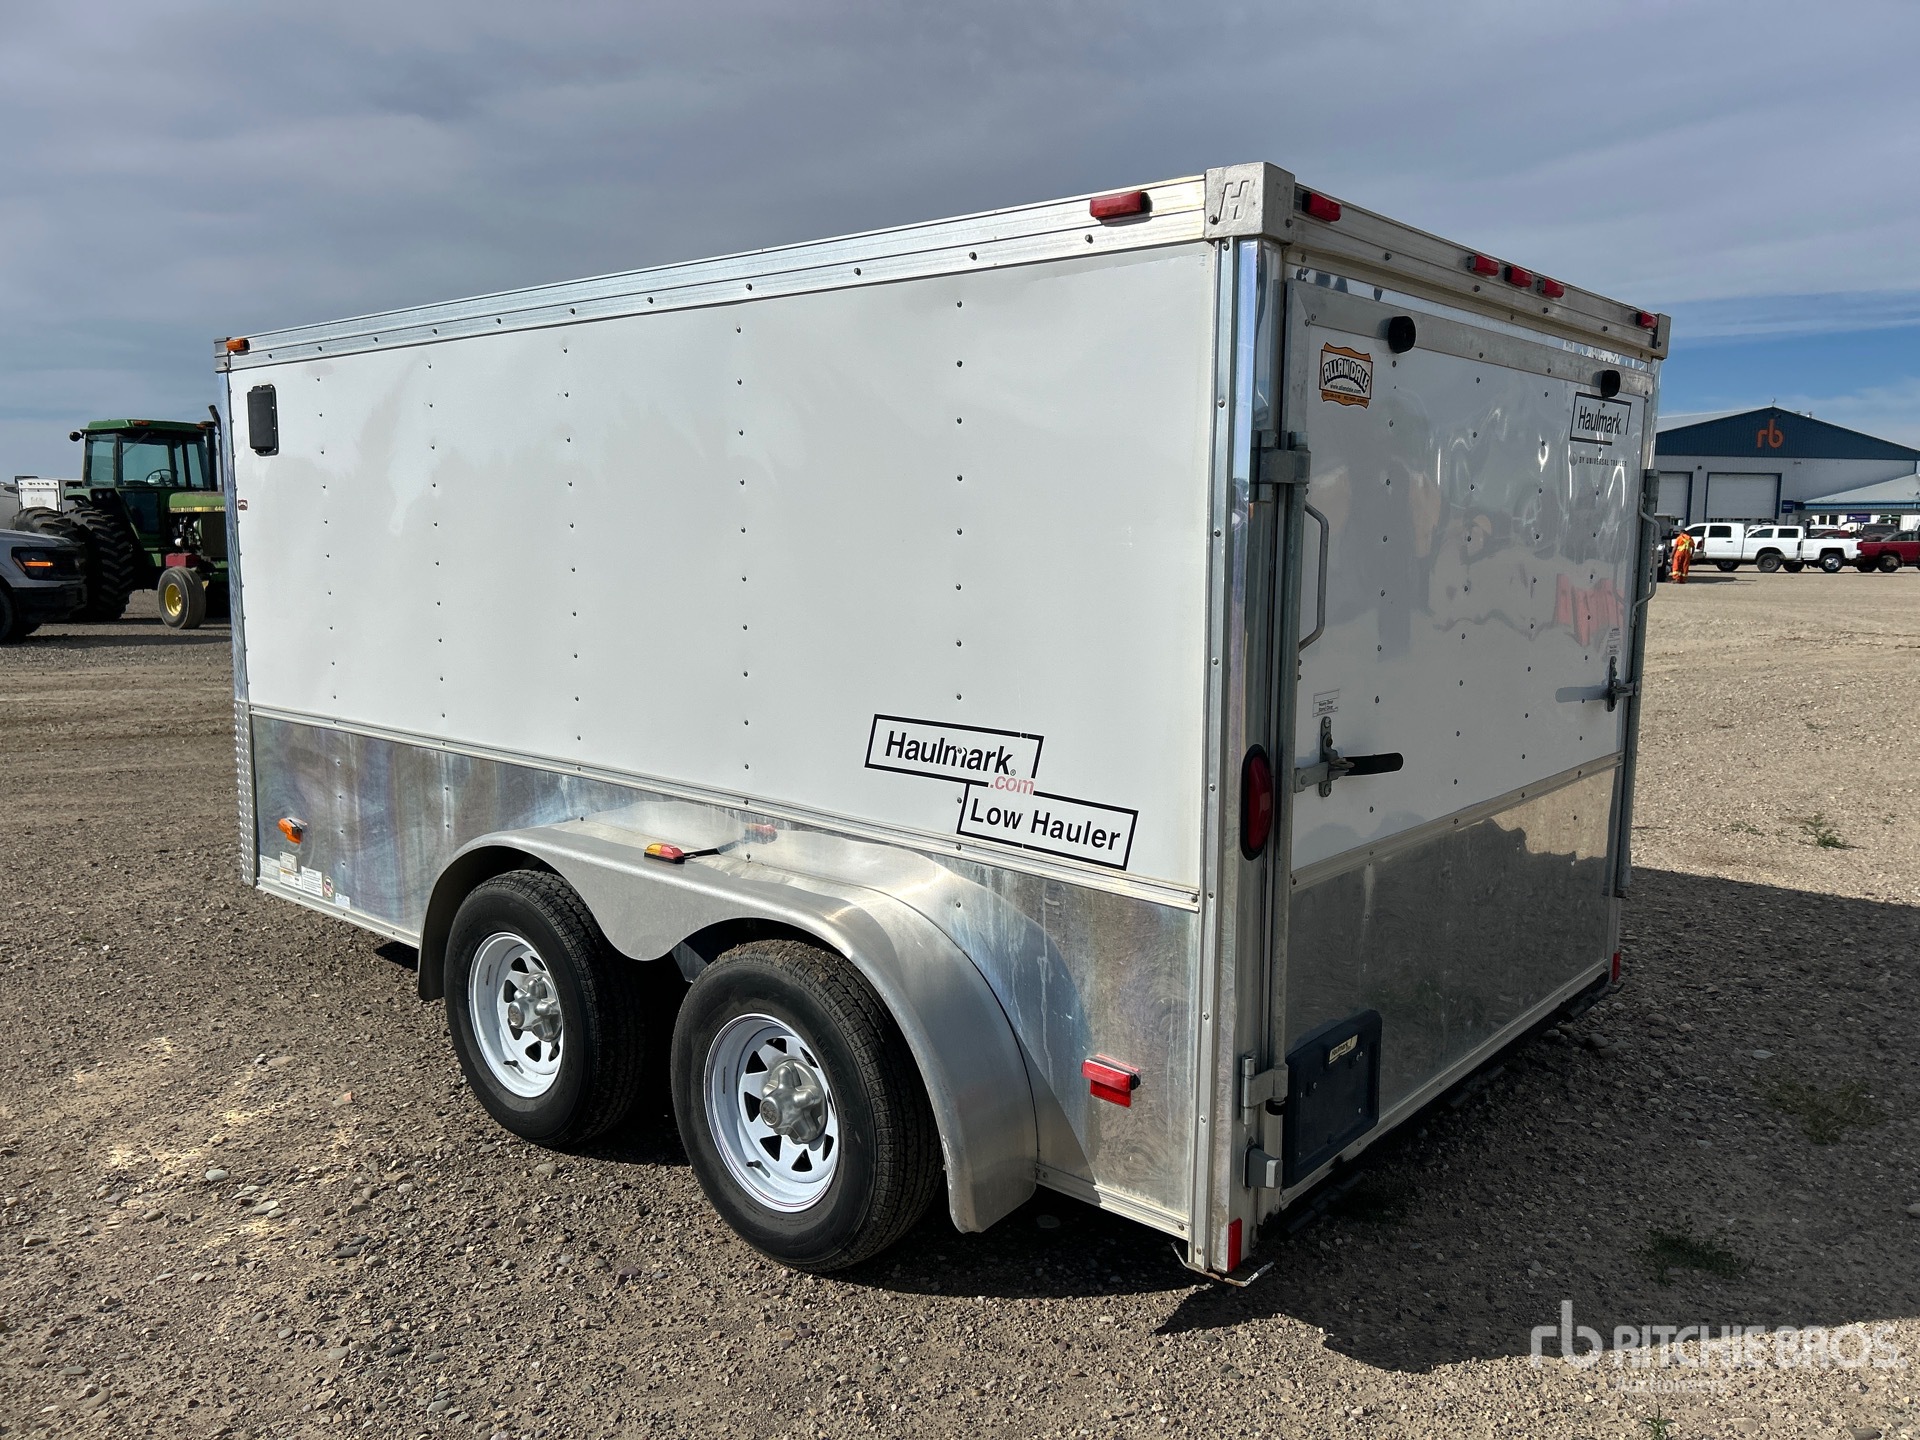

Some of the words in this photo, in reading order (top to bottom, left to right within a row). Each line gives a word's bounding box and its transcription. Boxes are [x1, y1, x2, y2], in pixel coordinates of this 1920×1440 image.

[1577, 405, 1621, 435] Haulmark
[1757, 418, 1784, 449] rb
[884, 730, 1014, 775] Haulmark
[989, 775, 1035, 795] .com
[970, 798, 1024, 830] Low
[1030, 809, 1121, 851] Hauler
